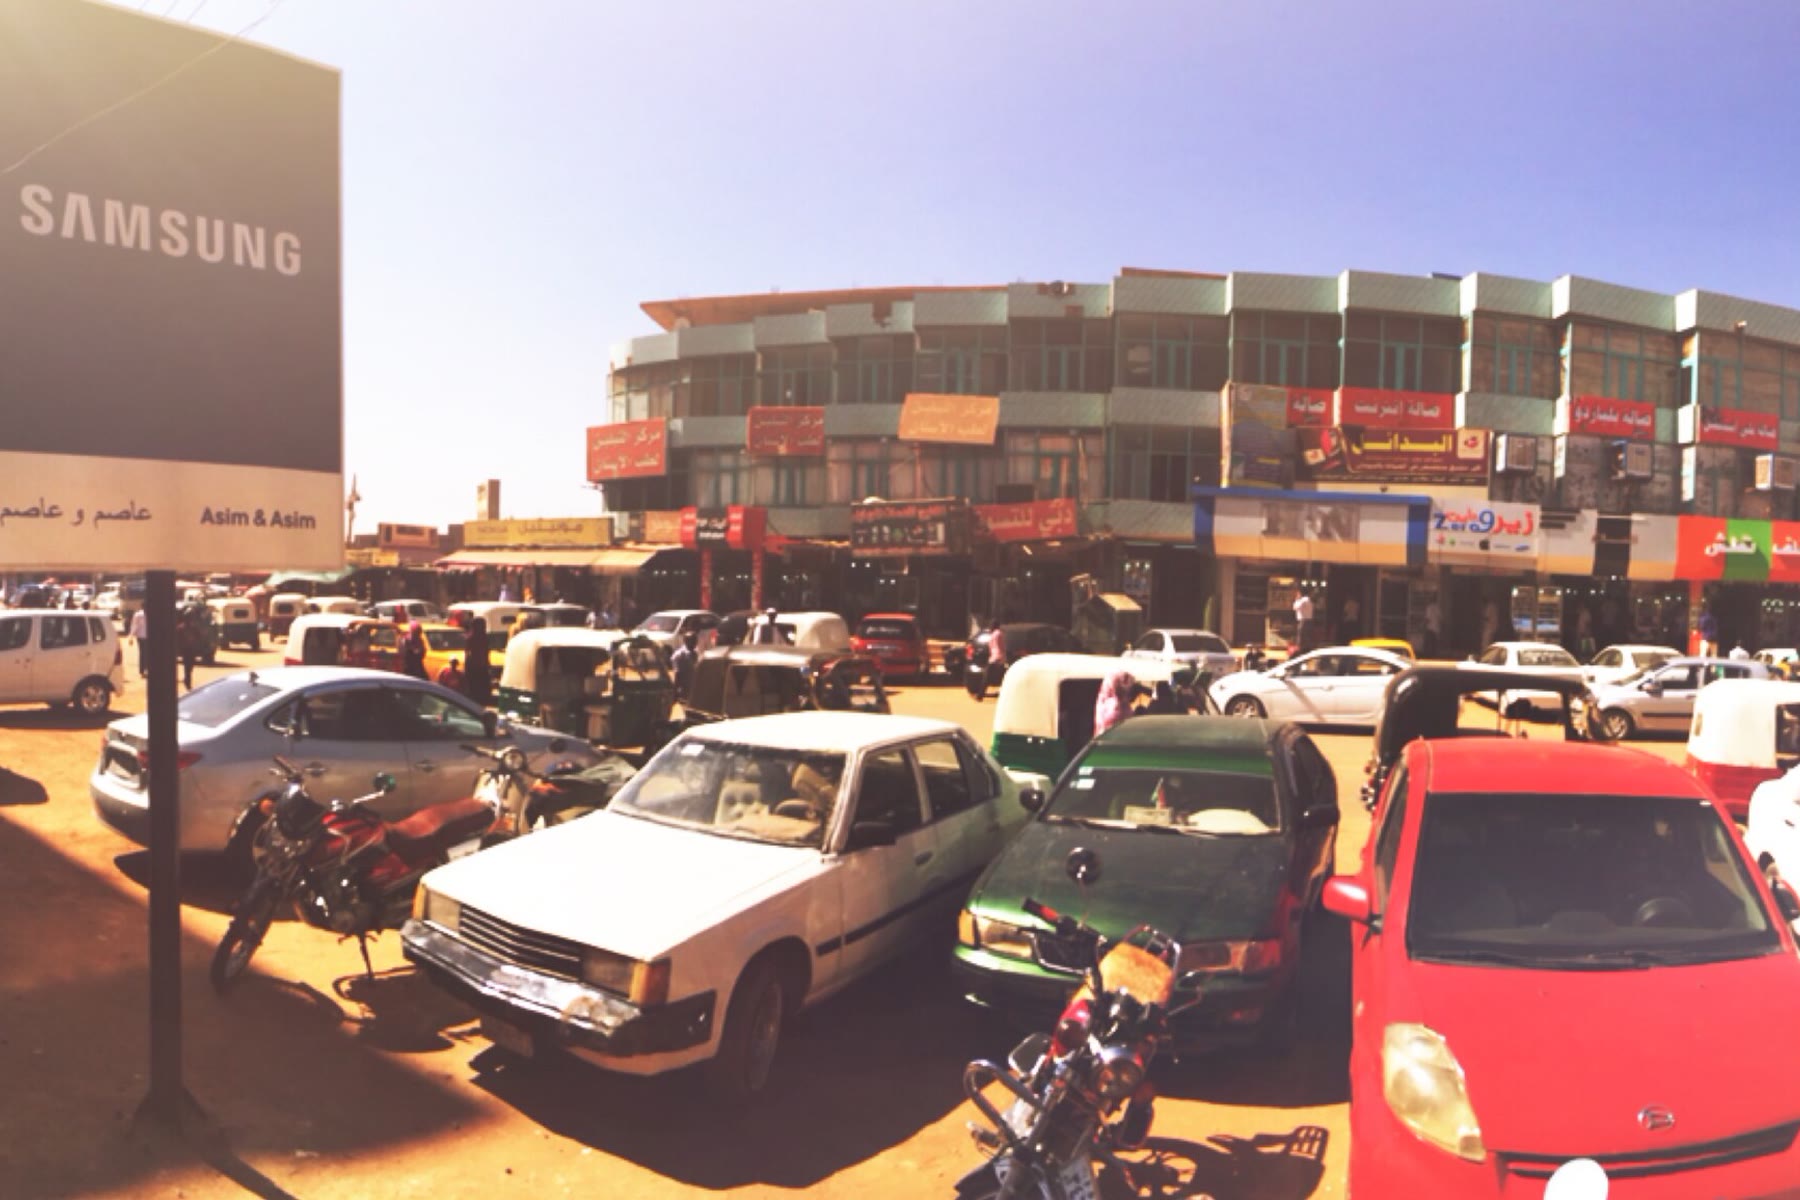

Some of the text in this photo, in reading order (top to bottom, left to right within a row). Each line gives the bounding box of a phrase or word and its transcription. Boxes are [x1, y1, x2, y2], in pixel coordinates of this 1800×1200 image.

[20, 184, 302, 276] SAMSUNG
[0, 498, 152, 528] عاصم و عاصم
[199, 506, 317, 529] Asim & Asim
